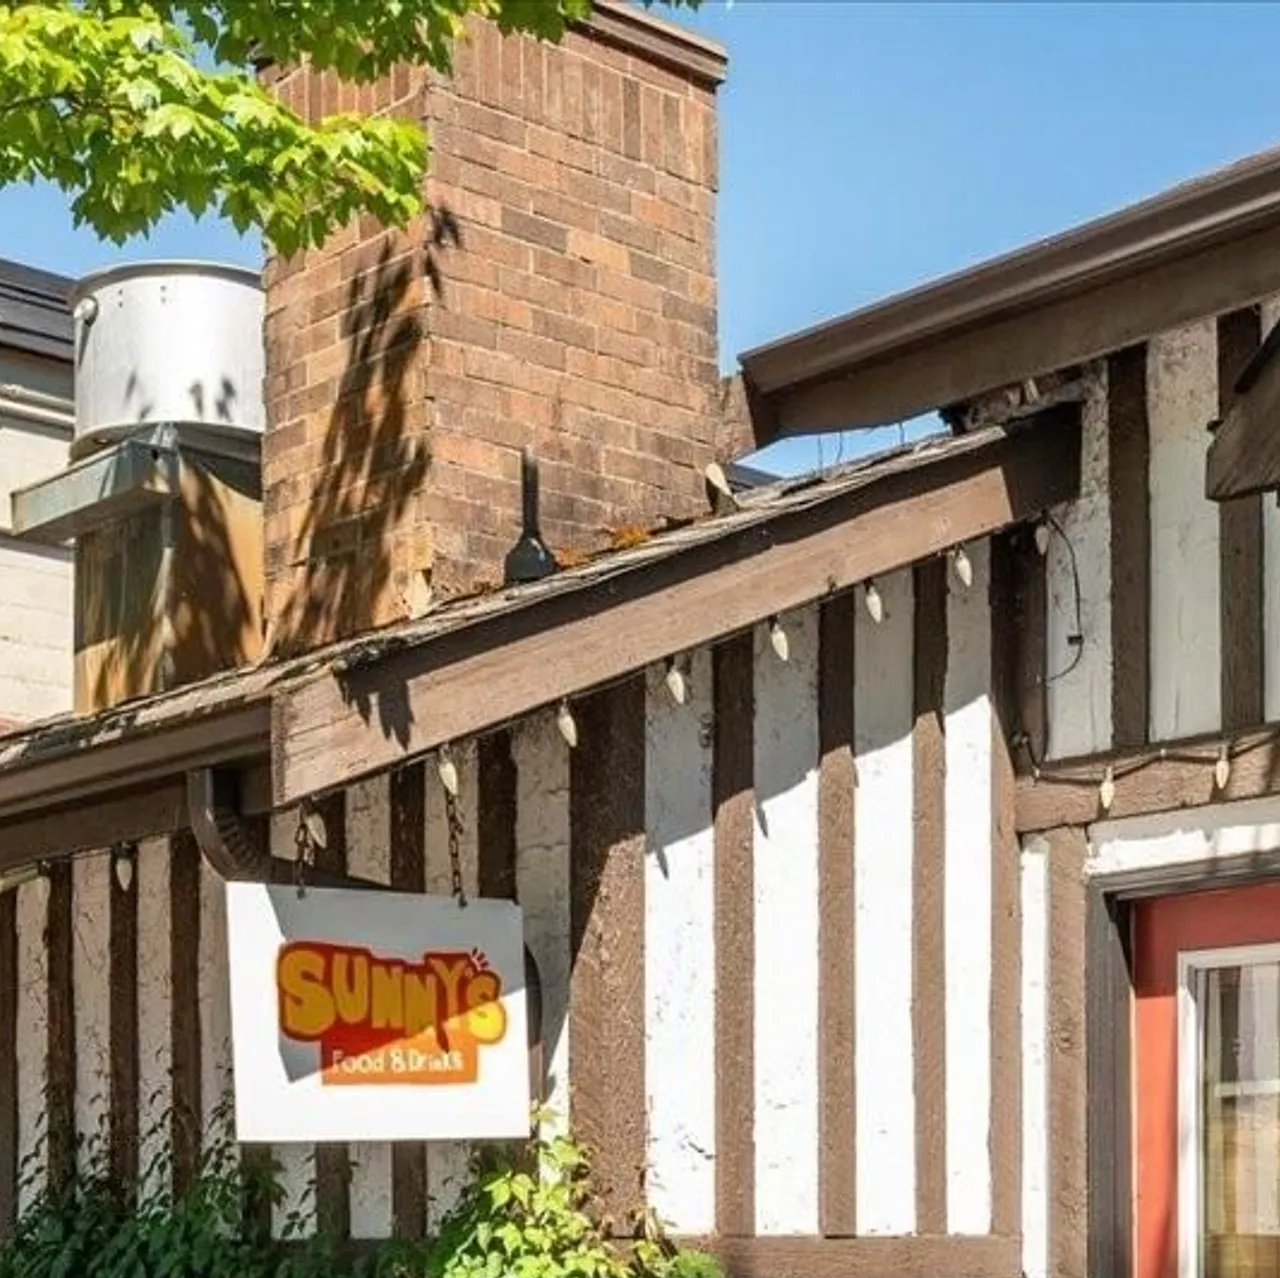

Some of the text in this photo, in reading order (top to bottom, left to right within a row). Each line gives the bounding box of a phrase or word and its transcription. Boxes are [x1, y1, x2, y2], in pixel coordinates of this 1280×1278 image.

[277, 943, 506, 1051] SUNNY'S
[331, 1049, 385, 1074] Food
[389, 1048, 405, 1073] &
